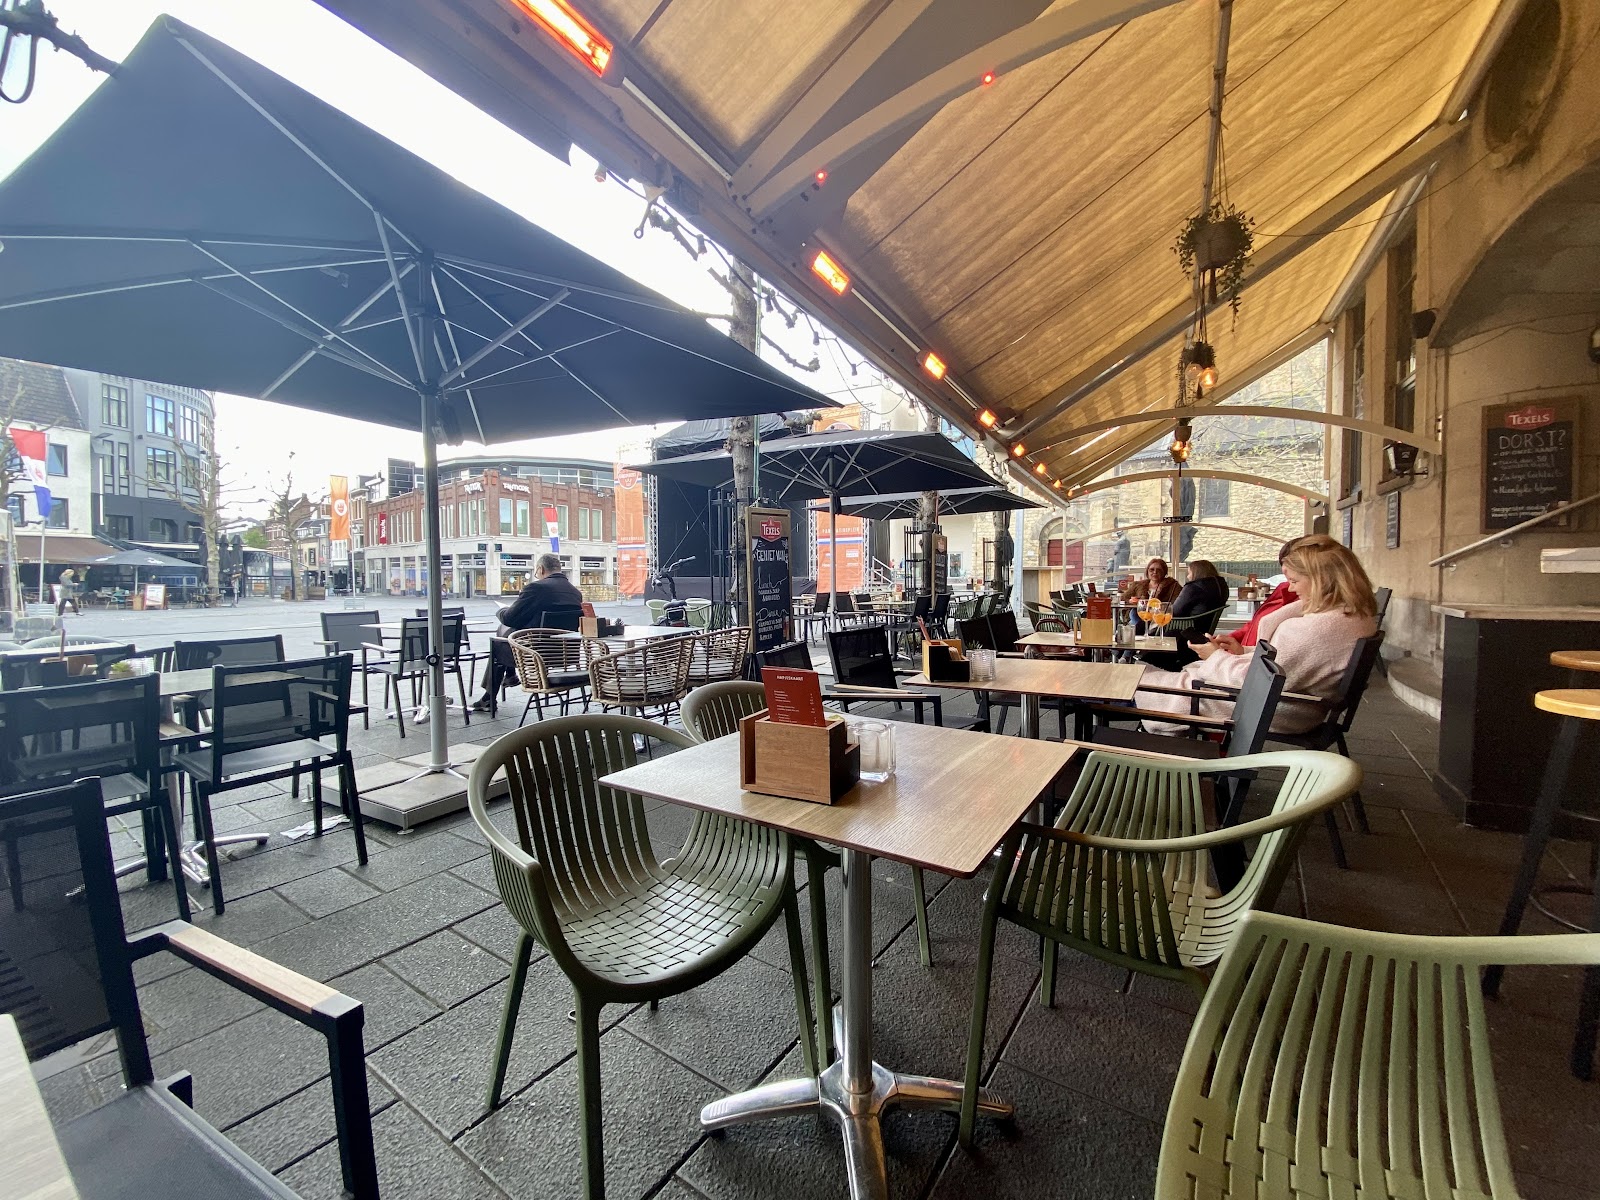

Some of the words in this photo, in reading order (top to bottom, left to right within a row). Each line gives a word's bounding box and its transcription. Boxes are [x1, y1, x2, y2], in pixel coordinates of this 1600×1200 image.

[1508, 413, 1550, 426] TEXELS
[1499, 429, 1567, 450] DORST?
[761, 523, 781, 536] TEXELS
[756, 550, 775, 562] GENIET
